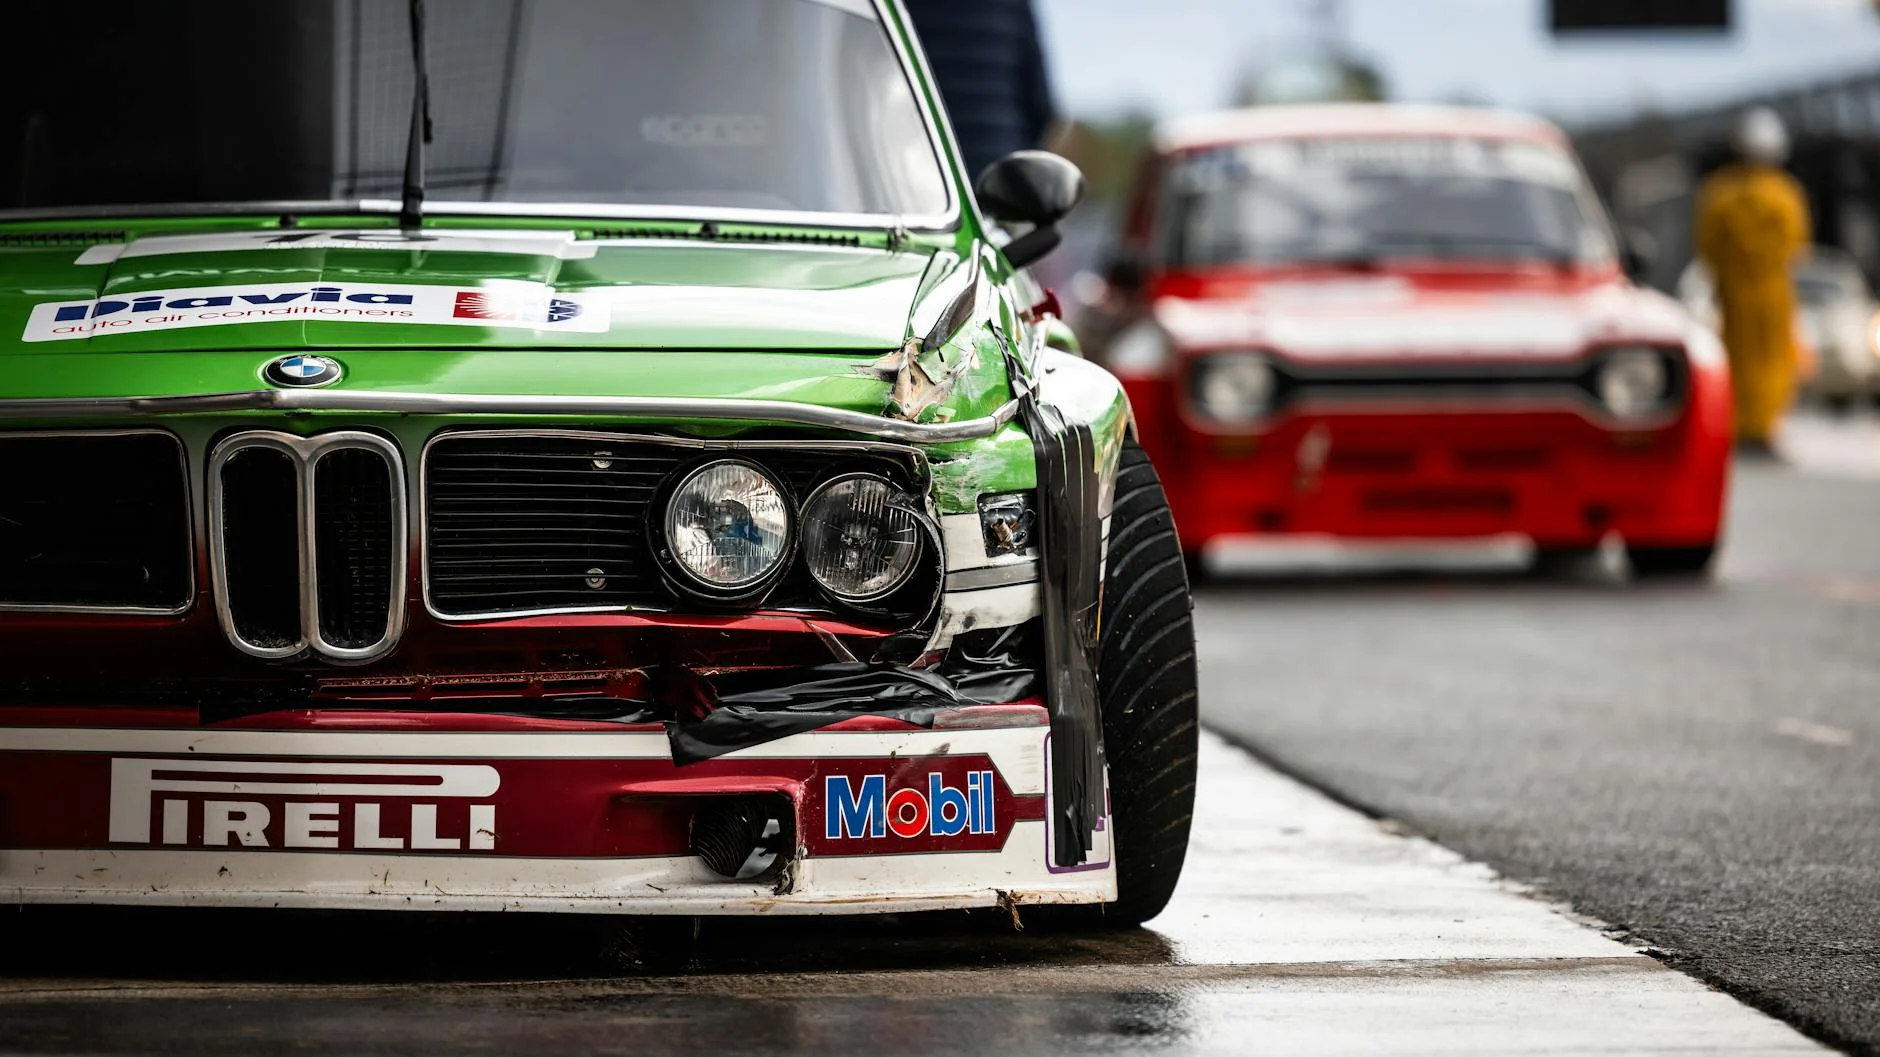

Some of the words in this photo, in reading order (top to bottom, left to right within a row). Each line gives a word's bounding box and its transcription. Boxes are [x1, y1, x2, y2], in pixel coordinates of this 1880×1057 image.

[53, 319, 132, 334] auto
[145, 314, 186, 324] air
[198, 306, 414, 320] conditioners
[54, 287, 413, 322] Diavia
[109, 757, 500, 850] PIRELLI
[825, 770, 995, 839] Mobil
